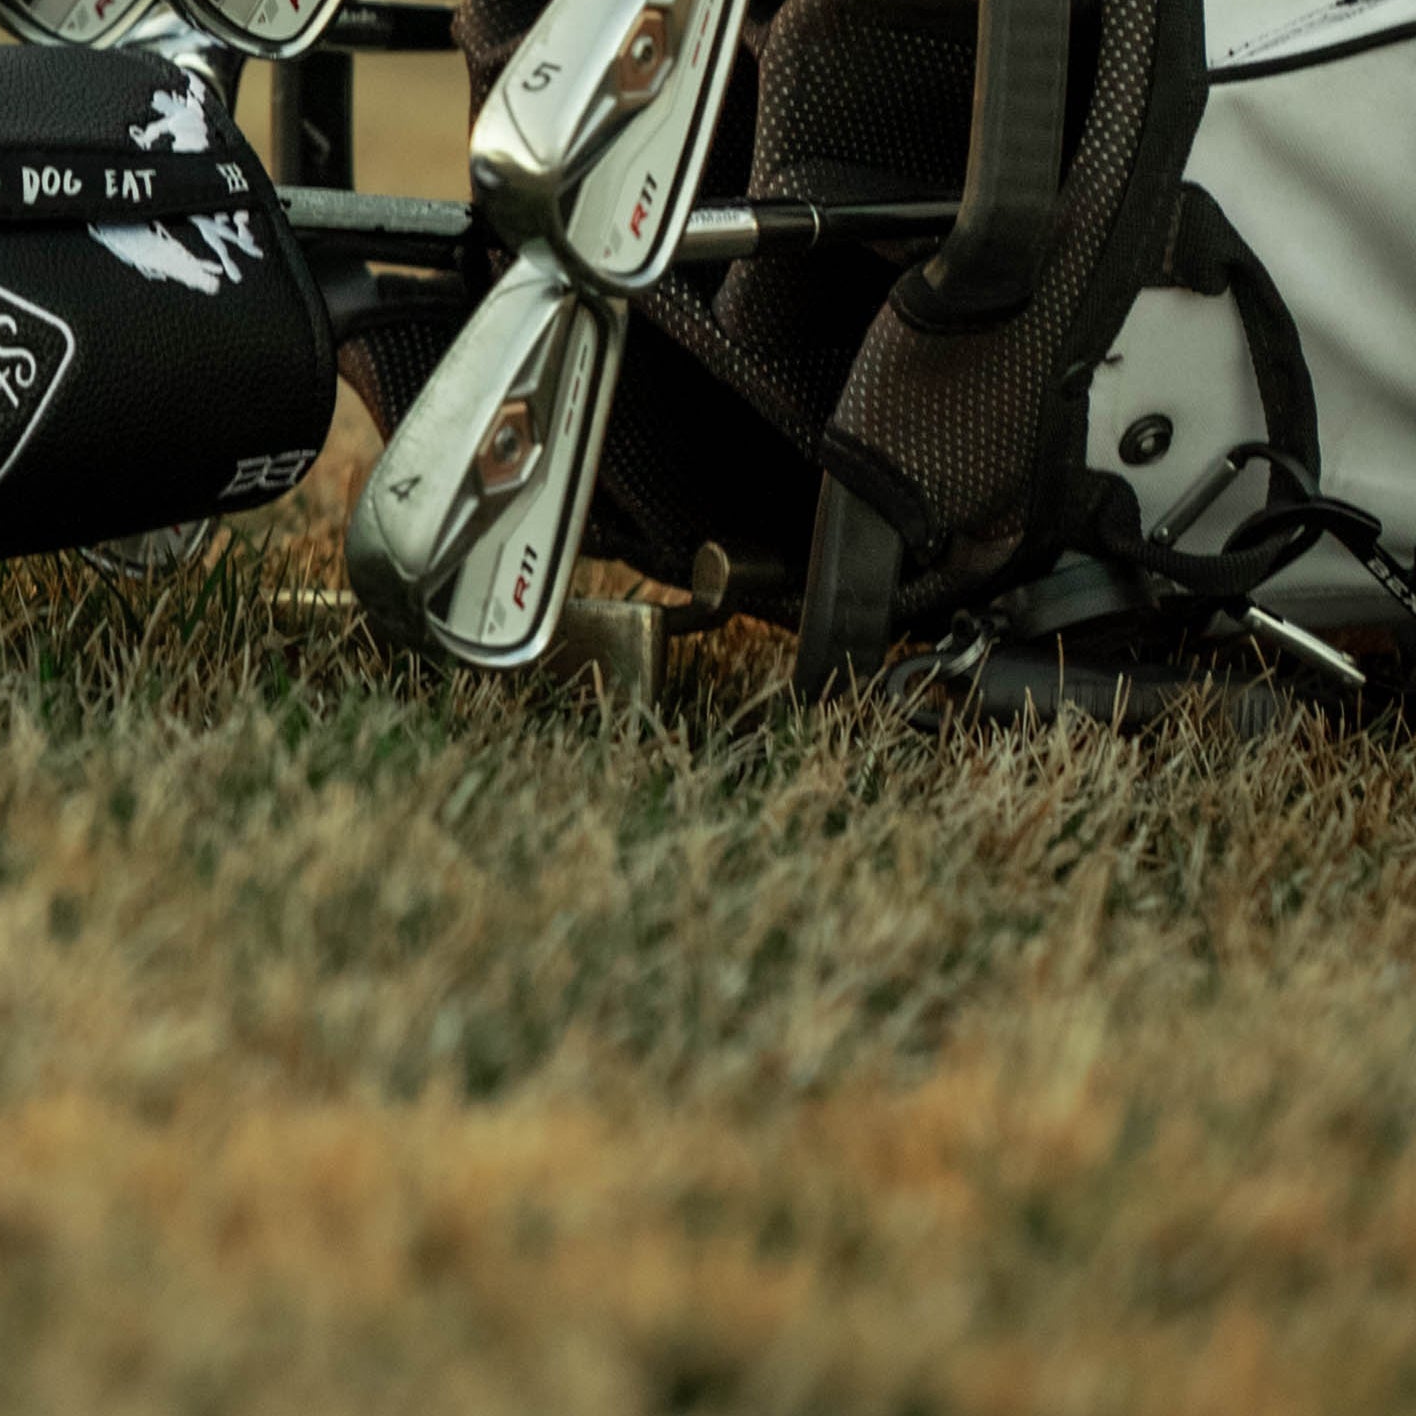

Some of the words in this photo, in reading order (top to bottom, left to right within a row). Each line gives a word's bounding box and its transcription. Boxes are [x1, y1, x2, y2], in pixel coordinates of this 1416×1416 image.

[522, 61, 562, 92] 5
[22, 166, 82, 206] DOG
[105, 168, 156, 202] EAT
[629, 171, 659, 240] R11
[390, 474, 422, 502] 4
[513, 544, 538, 612] R11
